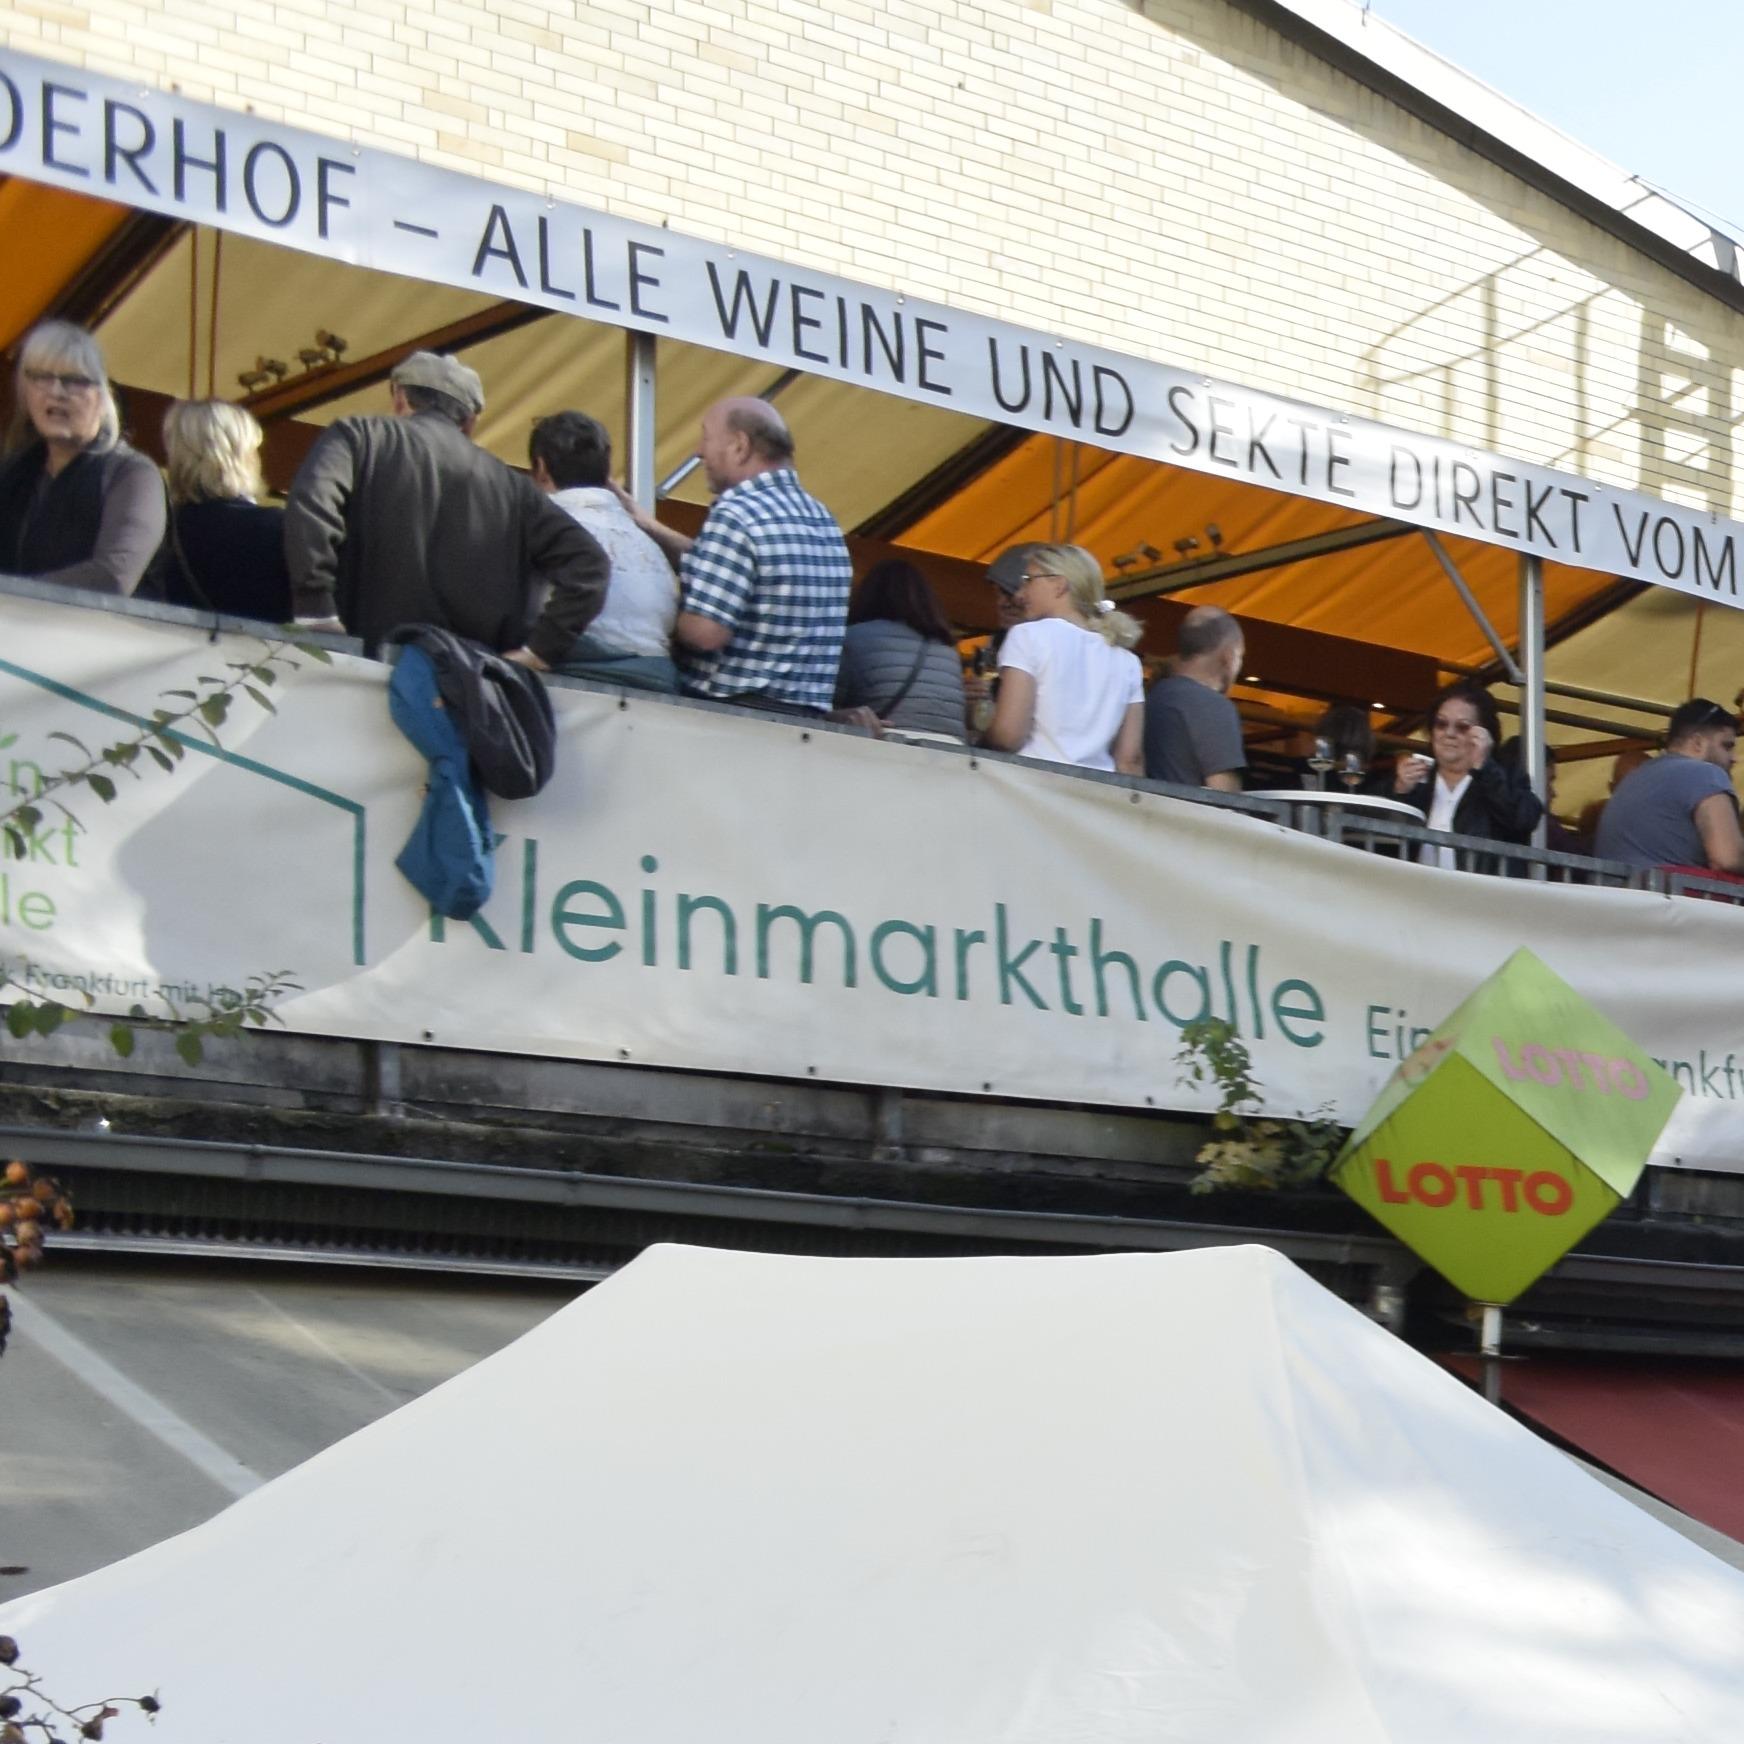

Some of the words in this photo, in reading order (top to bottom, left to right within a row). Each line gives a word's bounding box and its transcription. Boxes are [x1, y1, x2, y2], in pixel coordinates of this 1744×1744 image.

[472, 204, 669, 325] ALLE
[706, 258, 954, 397] WEINE
[987, 336, 1135, 438] UND
[1167, 385, 1355, 498] SEKTE
[1389, 442, 1590, 555] DIREKT
[1612, 503, 1738, 595] VOM
[1492, 1033, 1650, 1101] LOTTO
[1375, 1159, 1573, 1216] LOTTO
